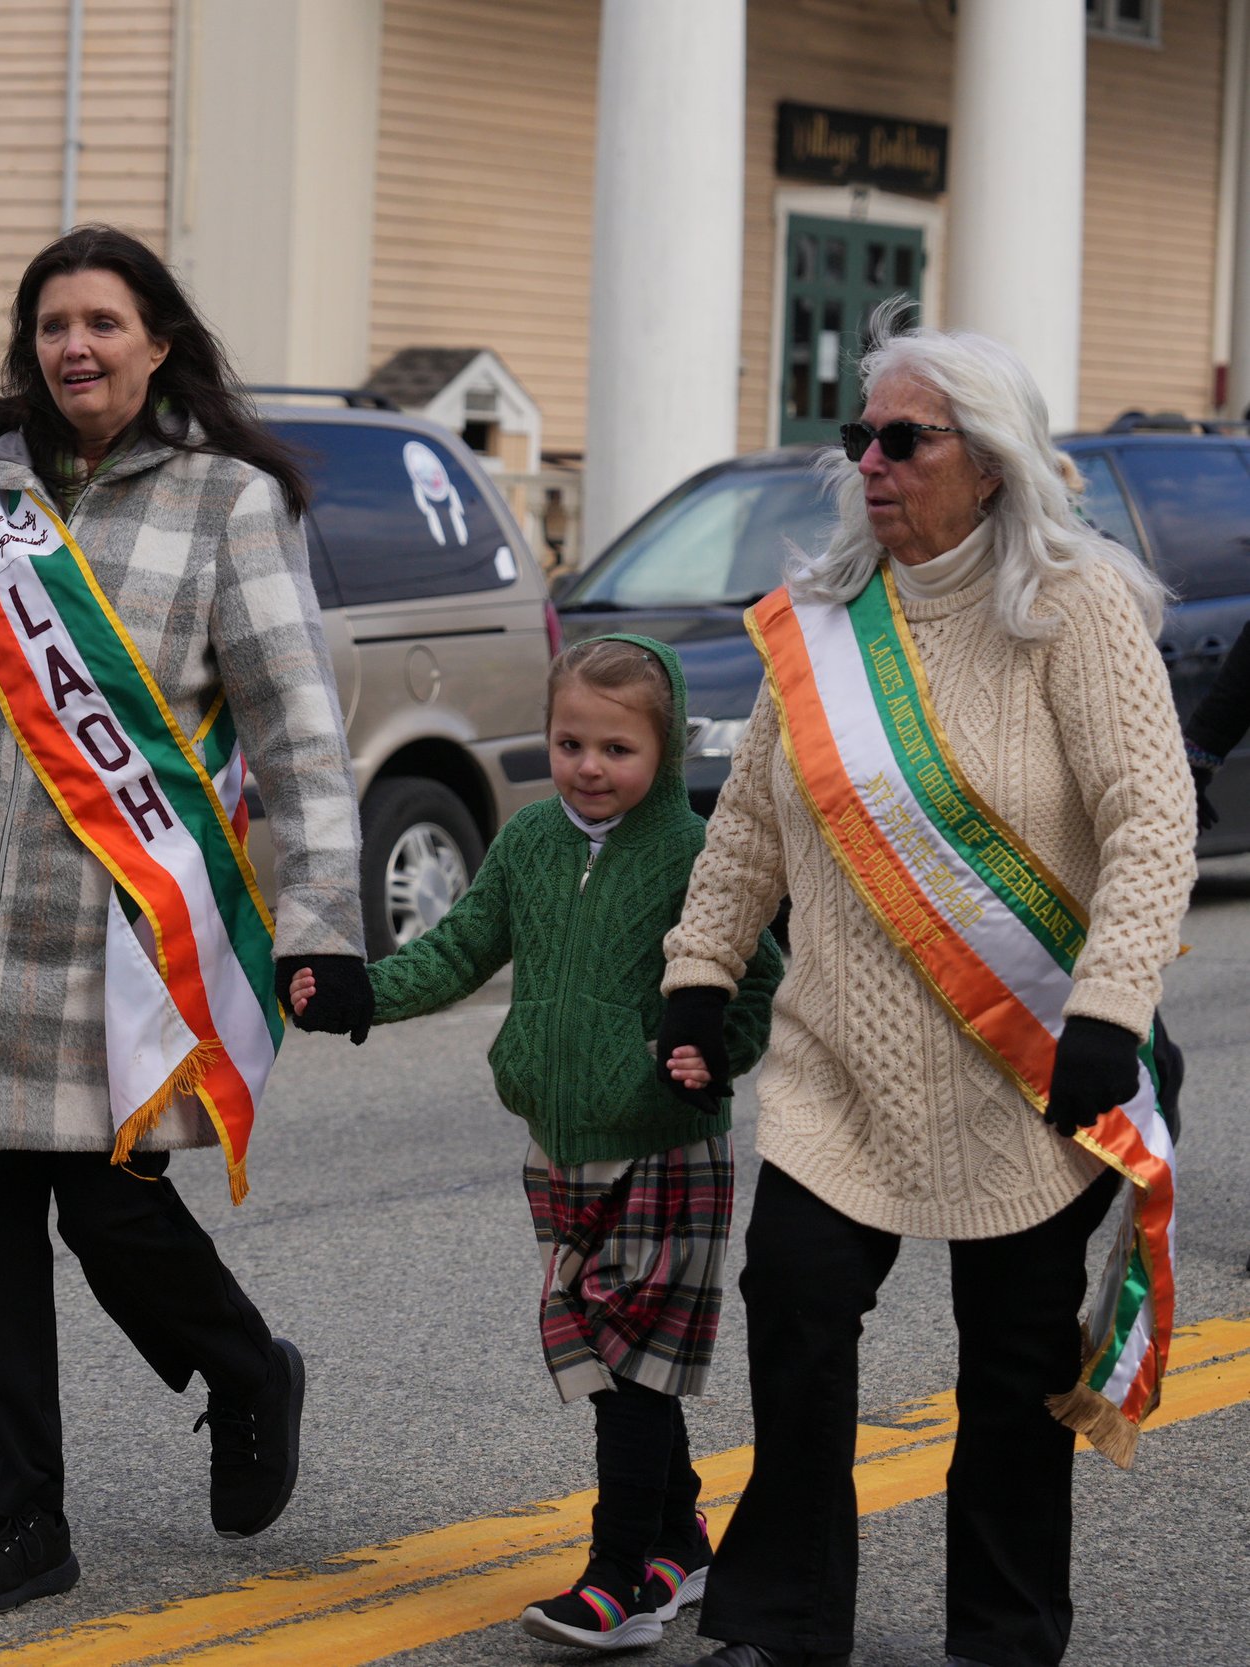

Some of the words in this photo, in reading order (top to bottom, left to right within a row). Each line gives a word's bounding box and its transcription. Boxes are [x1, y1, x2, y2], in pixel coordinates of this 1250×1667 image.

[7, 510, 36, 531] ounty
[8, 583, 174, 843] LAOH
[868, 633, 905, 696] LADIES
[887, 694, 932, 765] ANCIENT
[916, 762, 967, 826] ORDER
[957, 819, 989, 845] OF
[838, 804, 875, 855] VICE
[863, 848, 946, 950] PRESIDENT
[883, 804, 938, 870] STATE
[925, 863, 984, 928] BOARD
